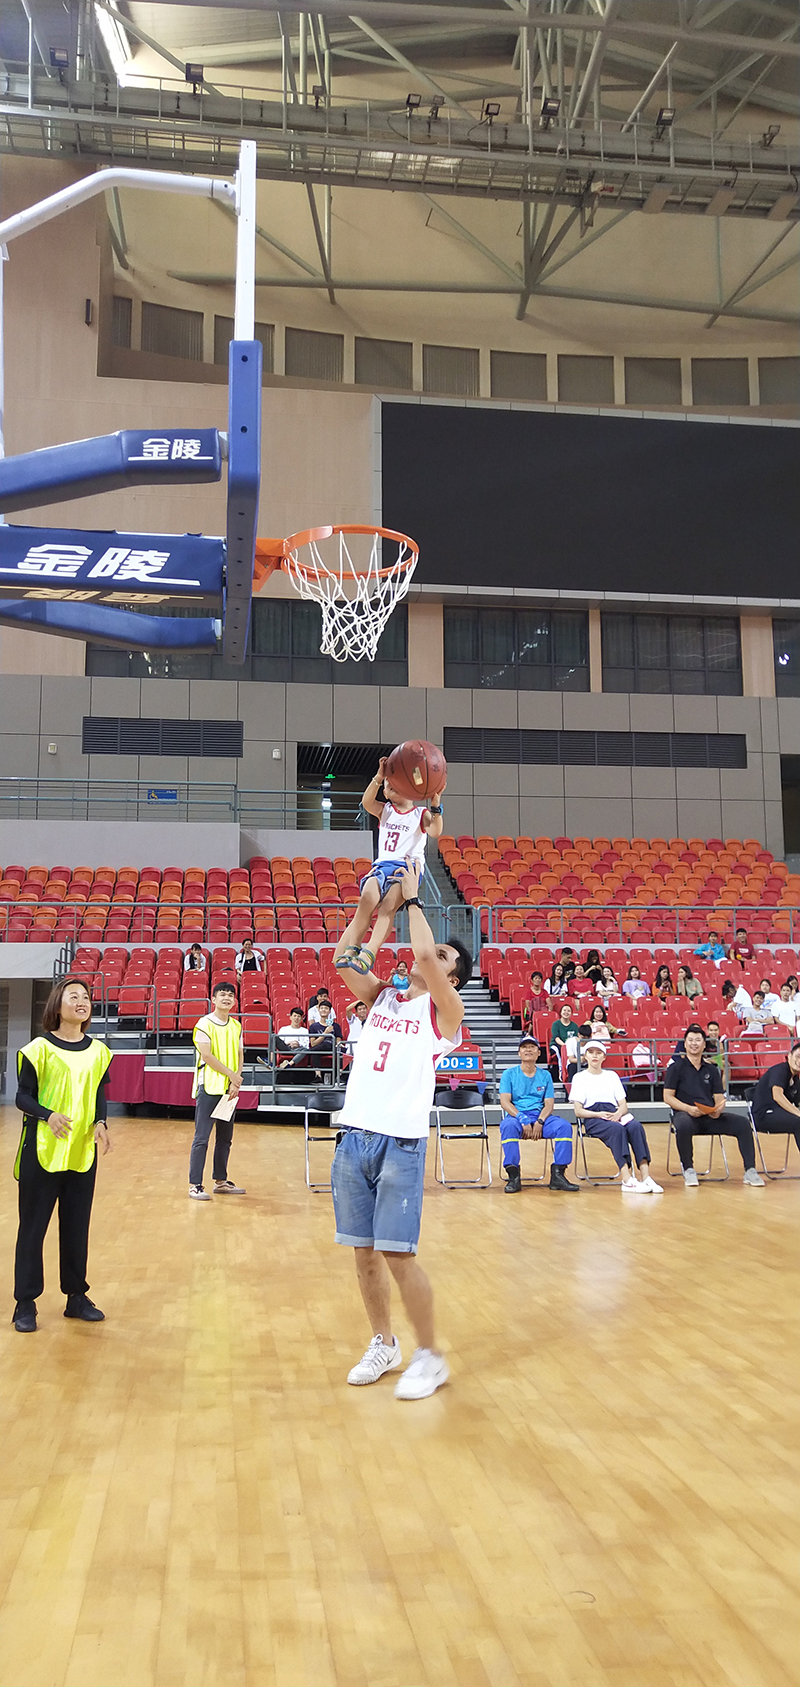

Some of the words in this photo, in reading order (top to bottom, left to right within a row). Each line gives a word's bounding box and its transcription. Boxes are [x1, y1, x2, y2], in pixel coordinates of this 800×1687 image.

[128, 438, 213, 460] 金陵
[0, 543, 201, 586] 金陵
[384, 831, 400, 852] 13
[369, 1012, 420, 1035] ROCKETS
[373, 1041, 391, 1072] 3
[440, 1056, 473, 1069] D0-3
